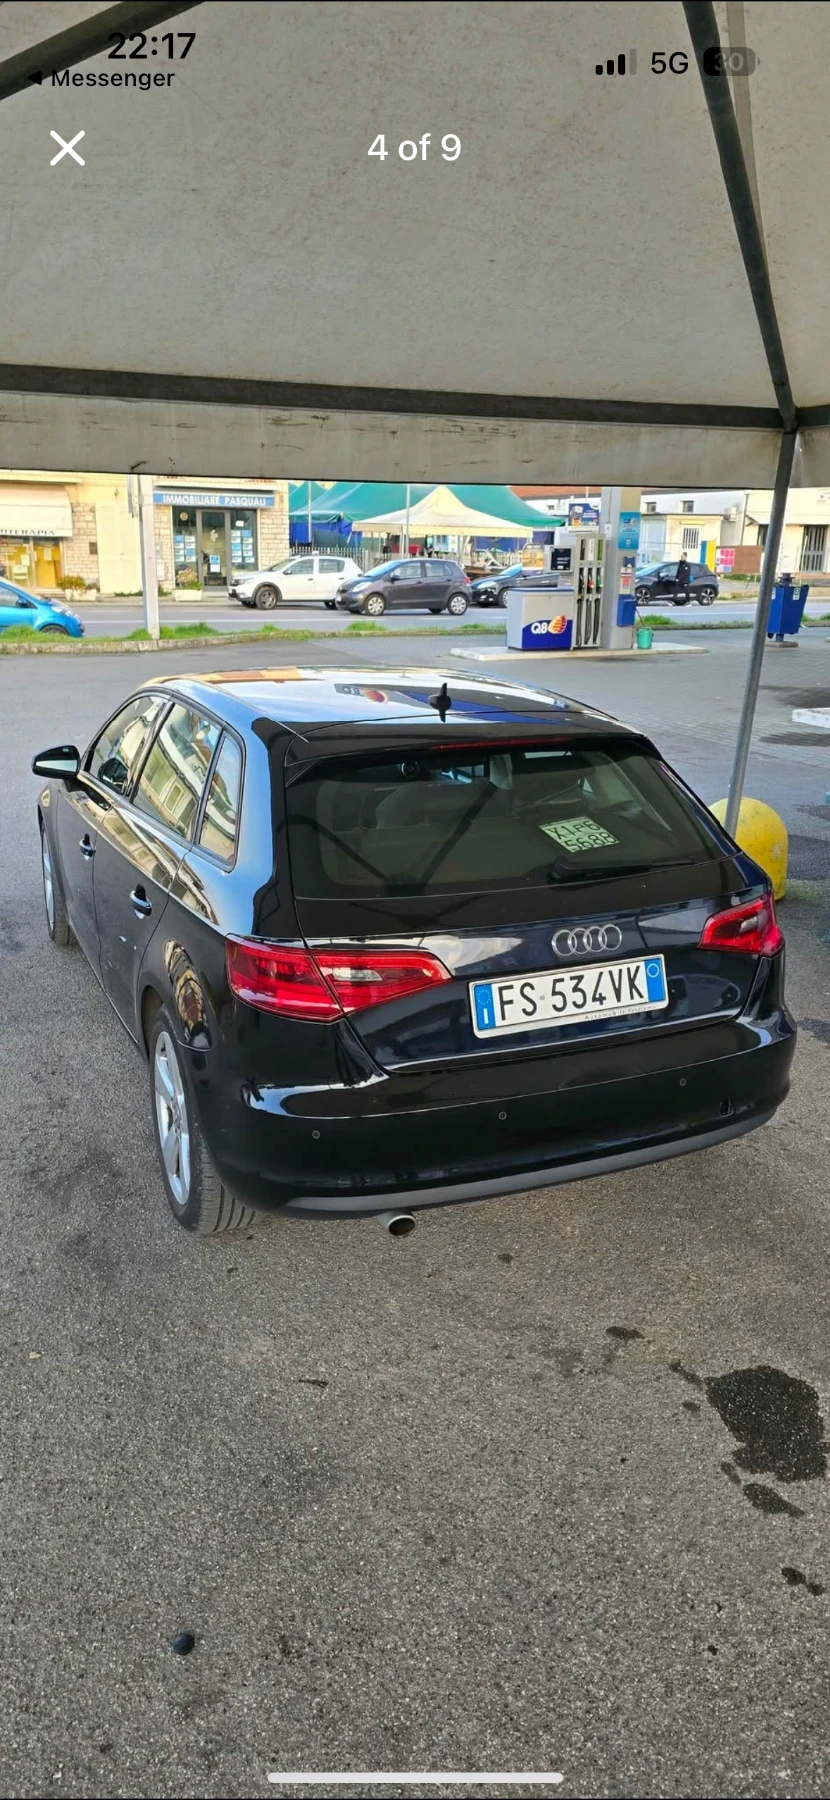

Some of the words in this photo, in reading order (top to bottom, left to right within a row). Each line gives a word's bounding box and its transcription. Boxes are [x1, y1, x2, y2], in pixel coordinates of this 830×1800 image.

[162, 494, 220, 506] IMMOBILIARE
[225, 497, 267, 507] PASQUALI
[530, 622, 549, 635] Q8
[498, 982, 537, 1021] FS
[551, 965, 644, 1013] 534VK
